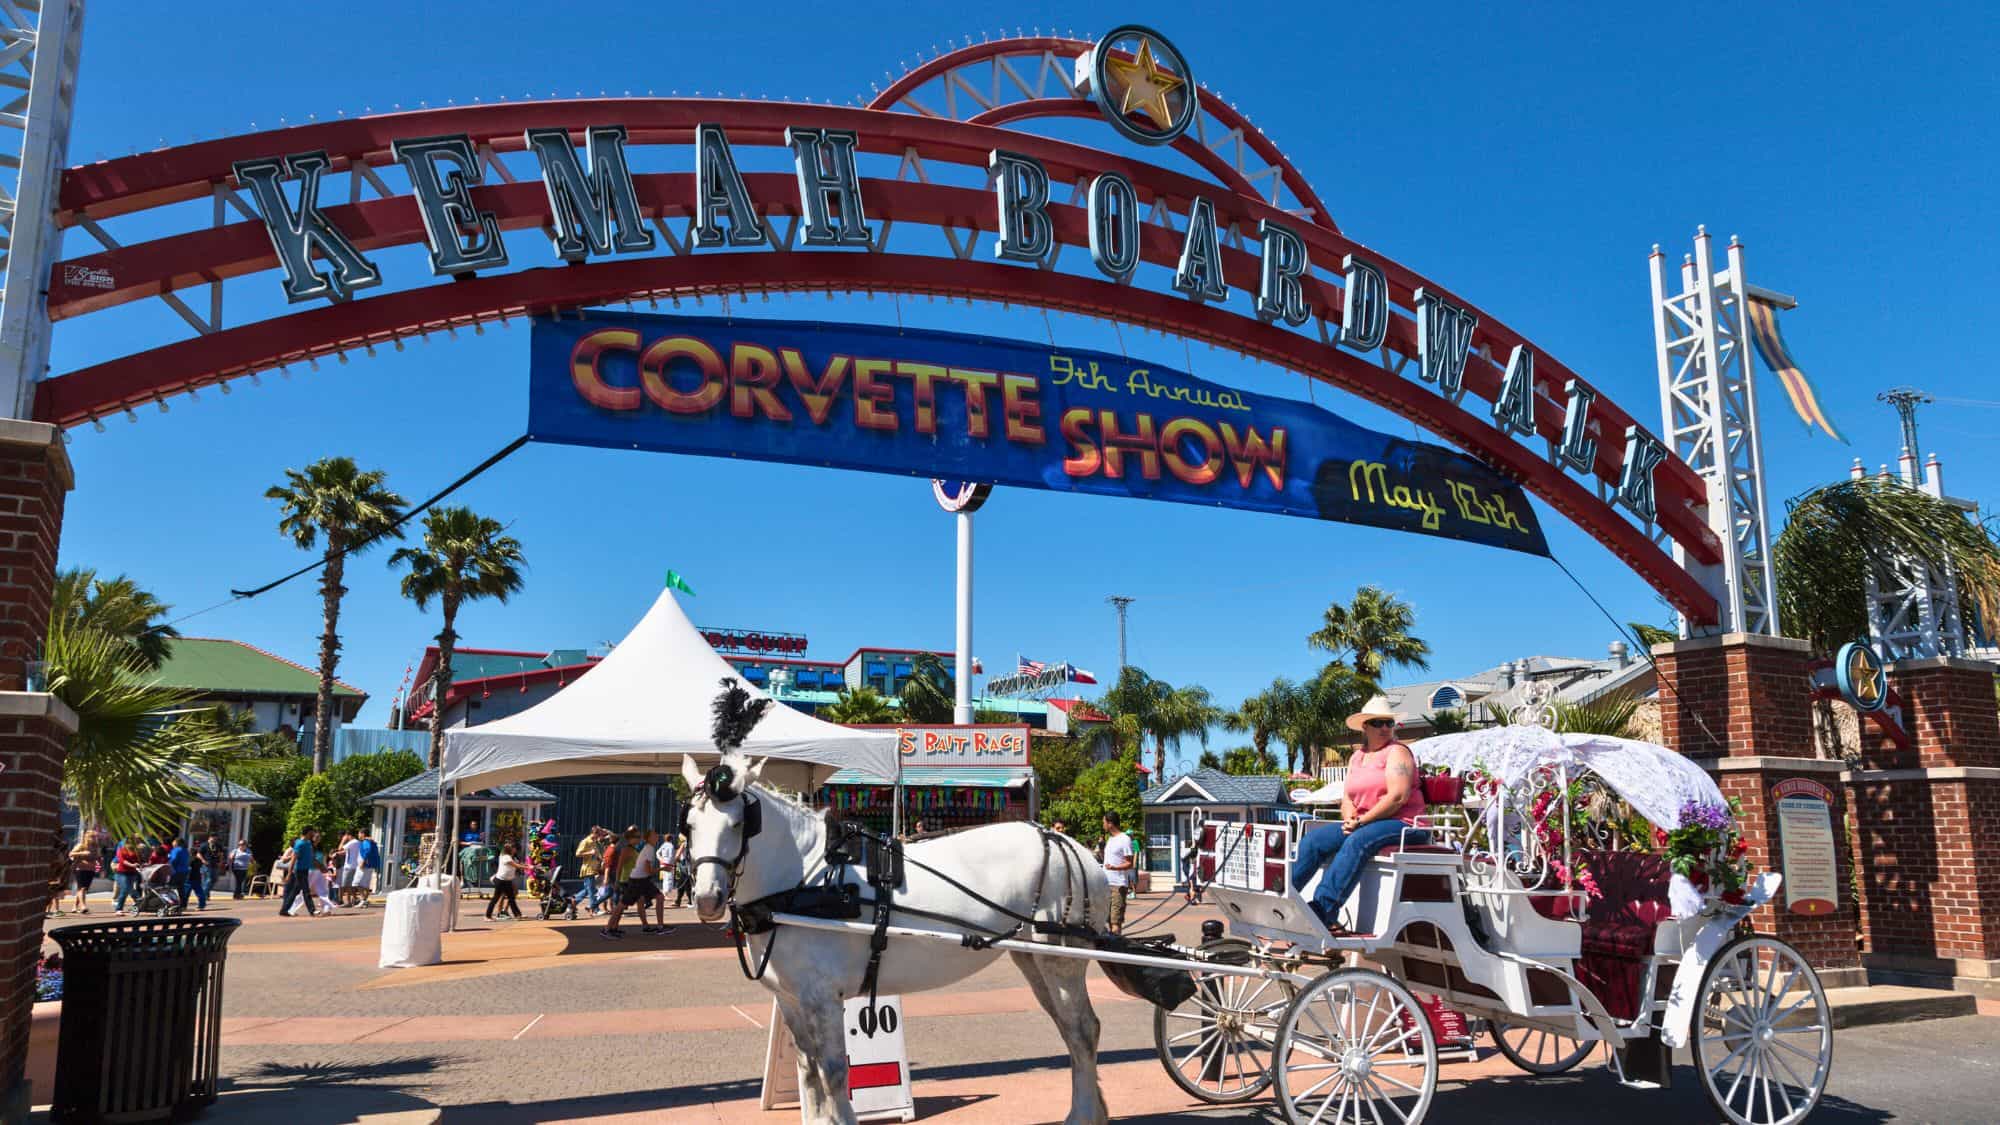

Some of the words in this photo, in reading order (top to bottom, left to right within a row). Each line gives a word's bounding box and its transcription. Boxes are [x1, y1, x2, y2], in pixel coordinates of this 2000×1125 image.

[232, 123, 875, 304] KEMAH
[988, 149, 1668, 523] BOARDWALK
[570, 328, 1046, 444] CORVETTE
[1060, 406, 1286, 491] SHOW
[1050, 355, 1117, 393] 9th
[1126, 370, 1251, 411] Annual
[1349, 459, 1446, 531] May
[743, 632, 808, 653] GUMP
[924, 731, 969, 755] BAIT
[973, 731, 1024, 756] RACE
